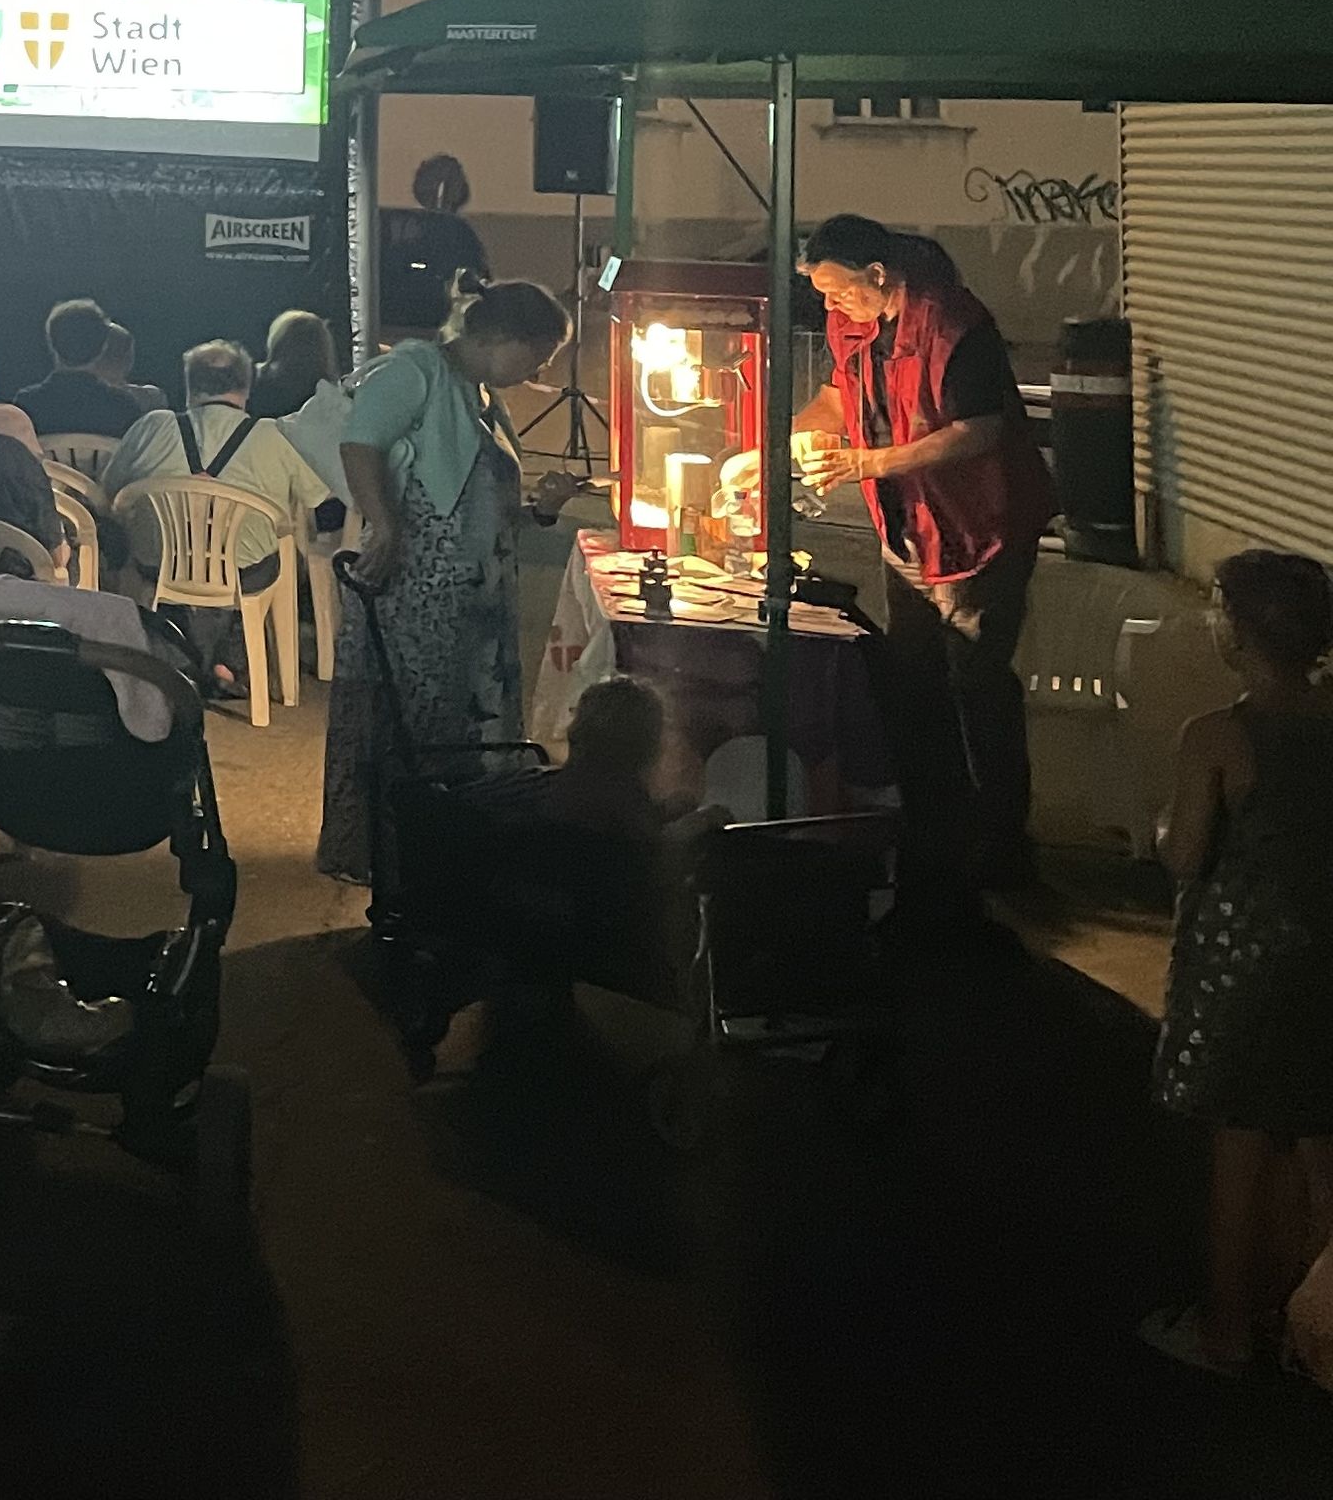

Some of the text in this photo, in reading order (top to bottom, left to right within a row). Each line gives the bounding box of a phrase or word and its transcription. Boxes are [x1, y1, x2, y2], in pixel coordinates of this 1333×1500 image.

[93, 12, 182, 40] Stadt
[92, 48, 182, 76] Wien
[211, 220, 304, 243] AIRSCREEN
